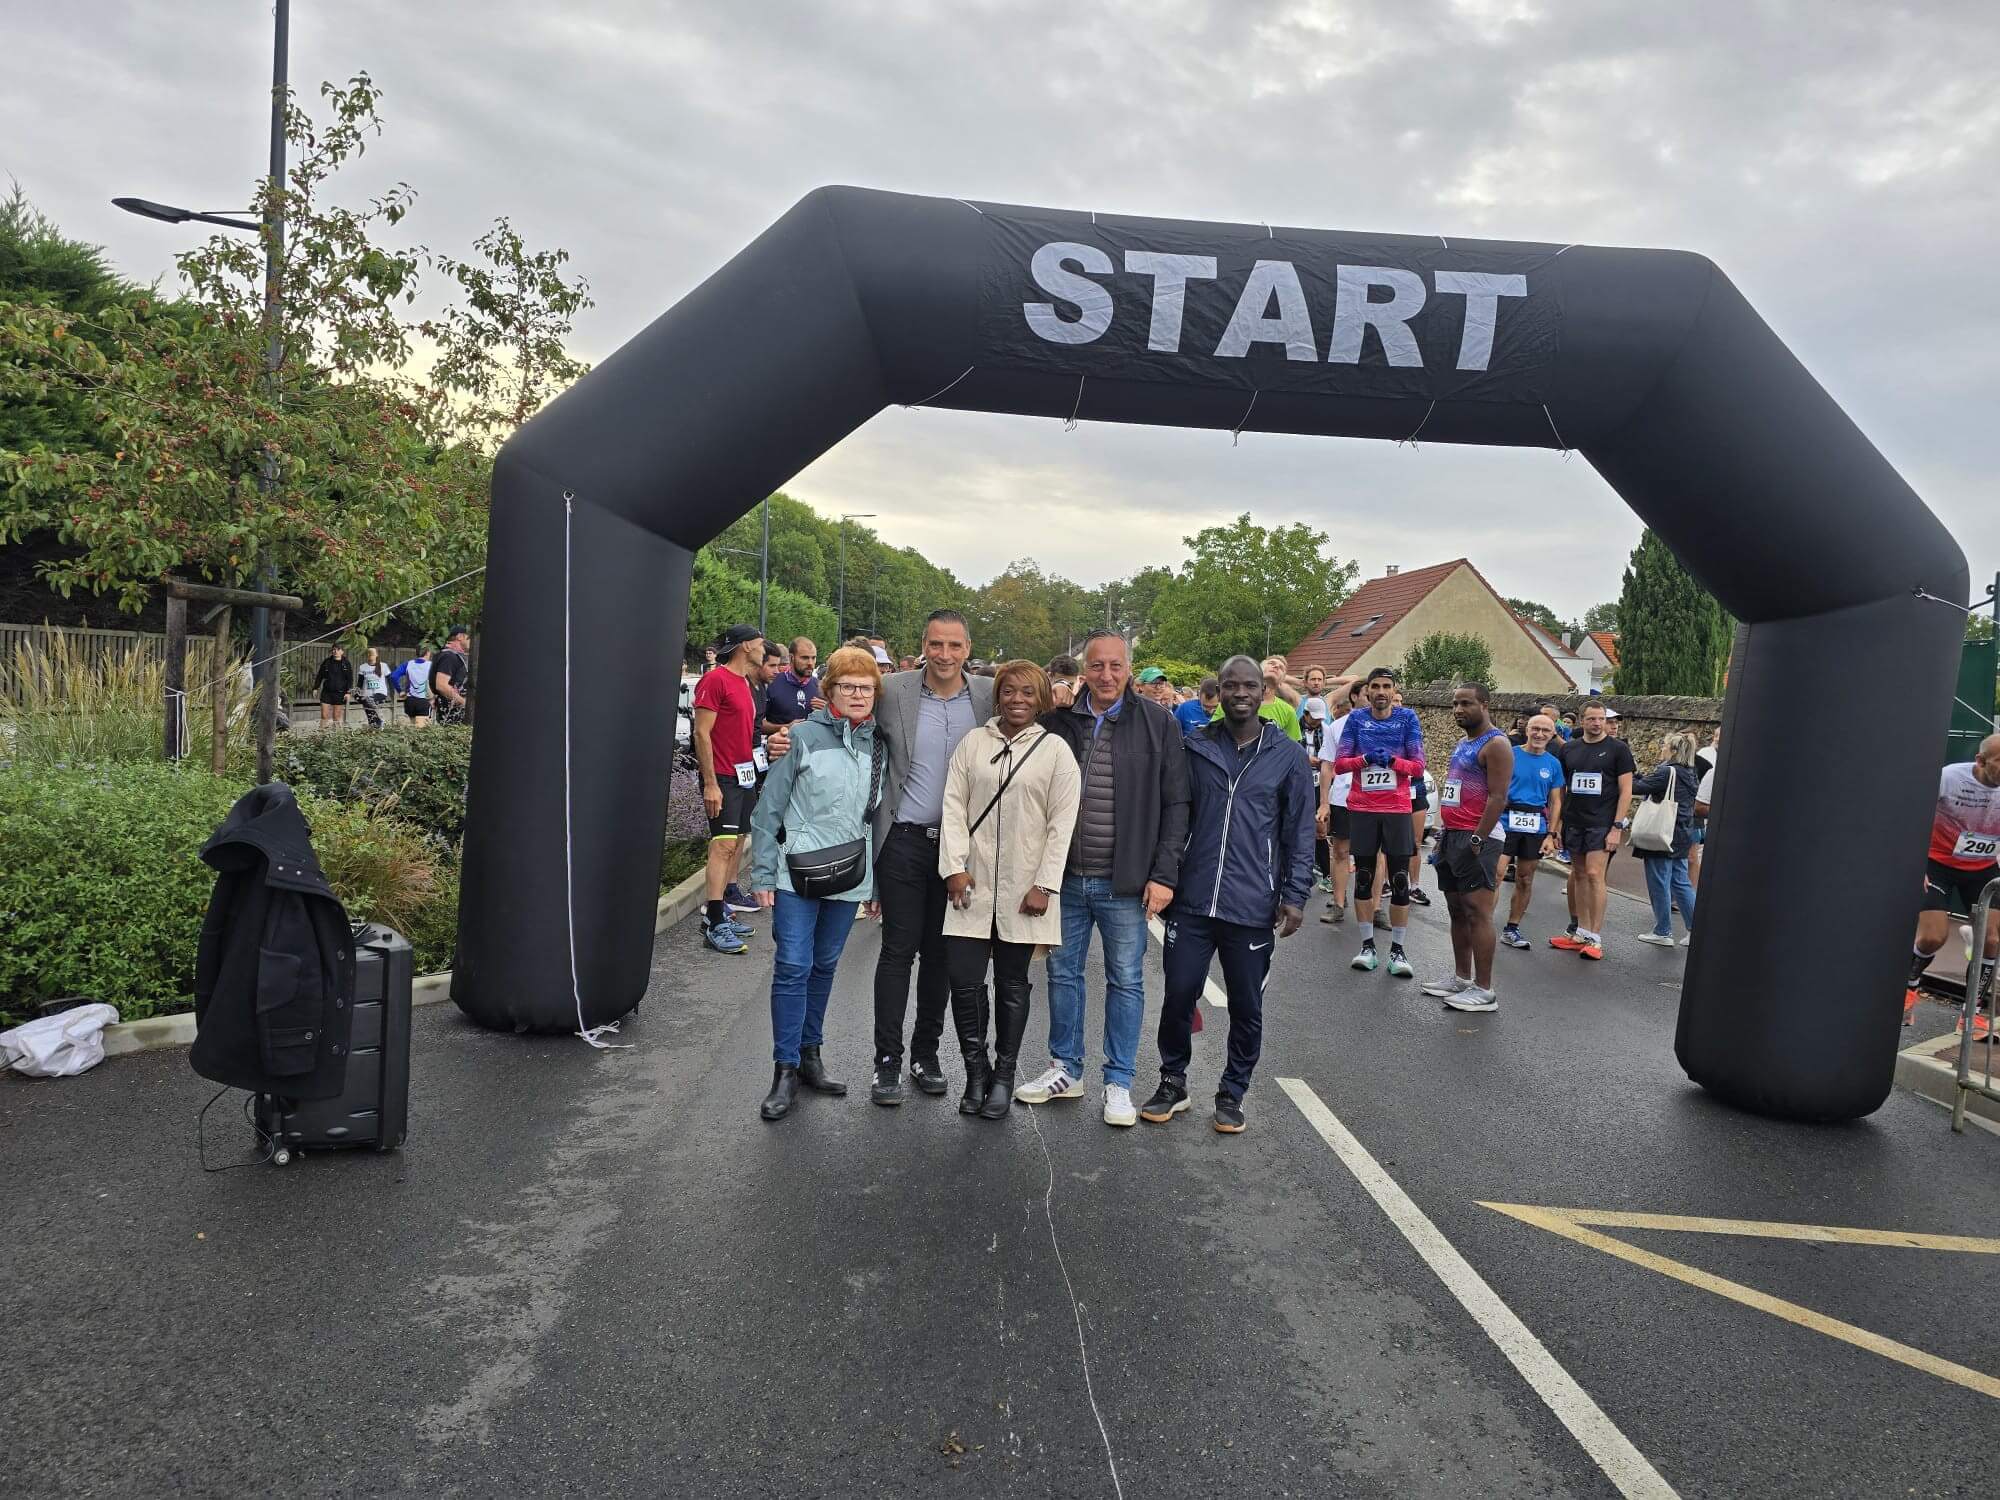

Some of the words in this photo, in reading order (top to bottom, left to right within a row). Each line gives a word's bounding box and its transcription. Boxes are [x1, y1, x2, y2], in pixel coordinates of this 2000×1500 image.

[1023, 242, 1527, 370] START
[1367, 772, 1391, 785] 272
[1577, 778, 1596, 789] 115
[1514, 816, 1535, 828] 254
[1963, 840, 1996, 854] 290
